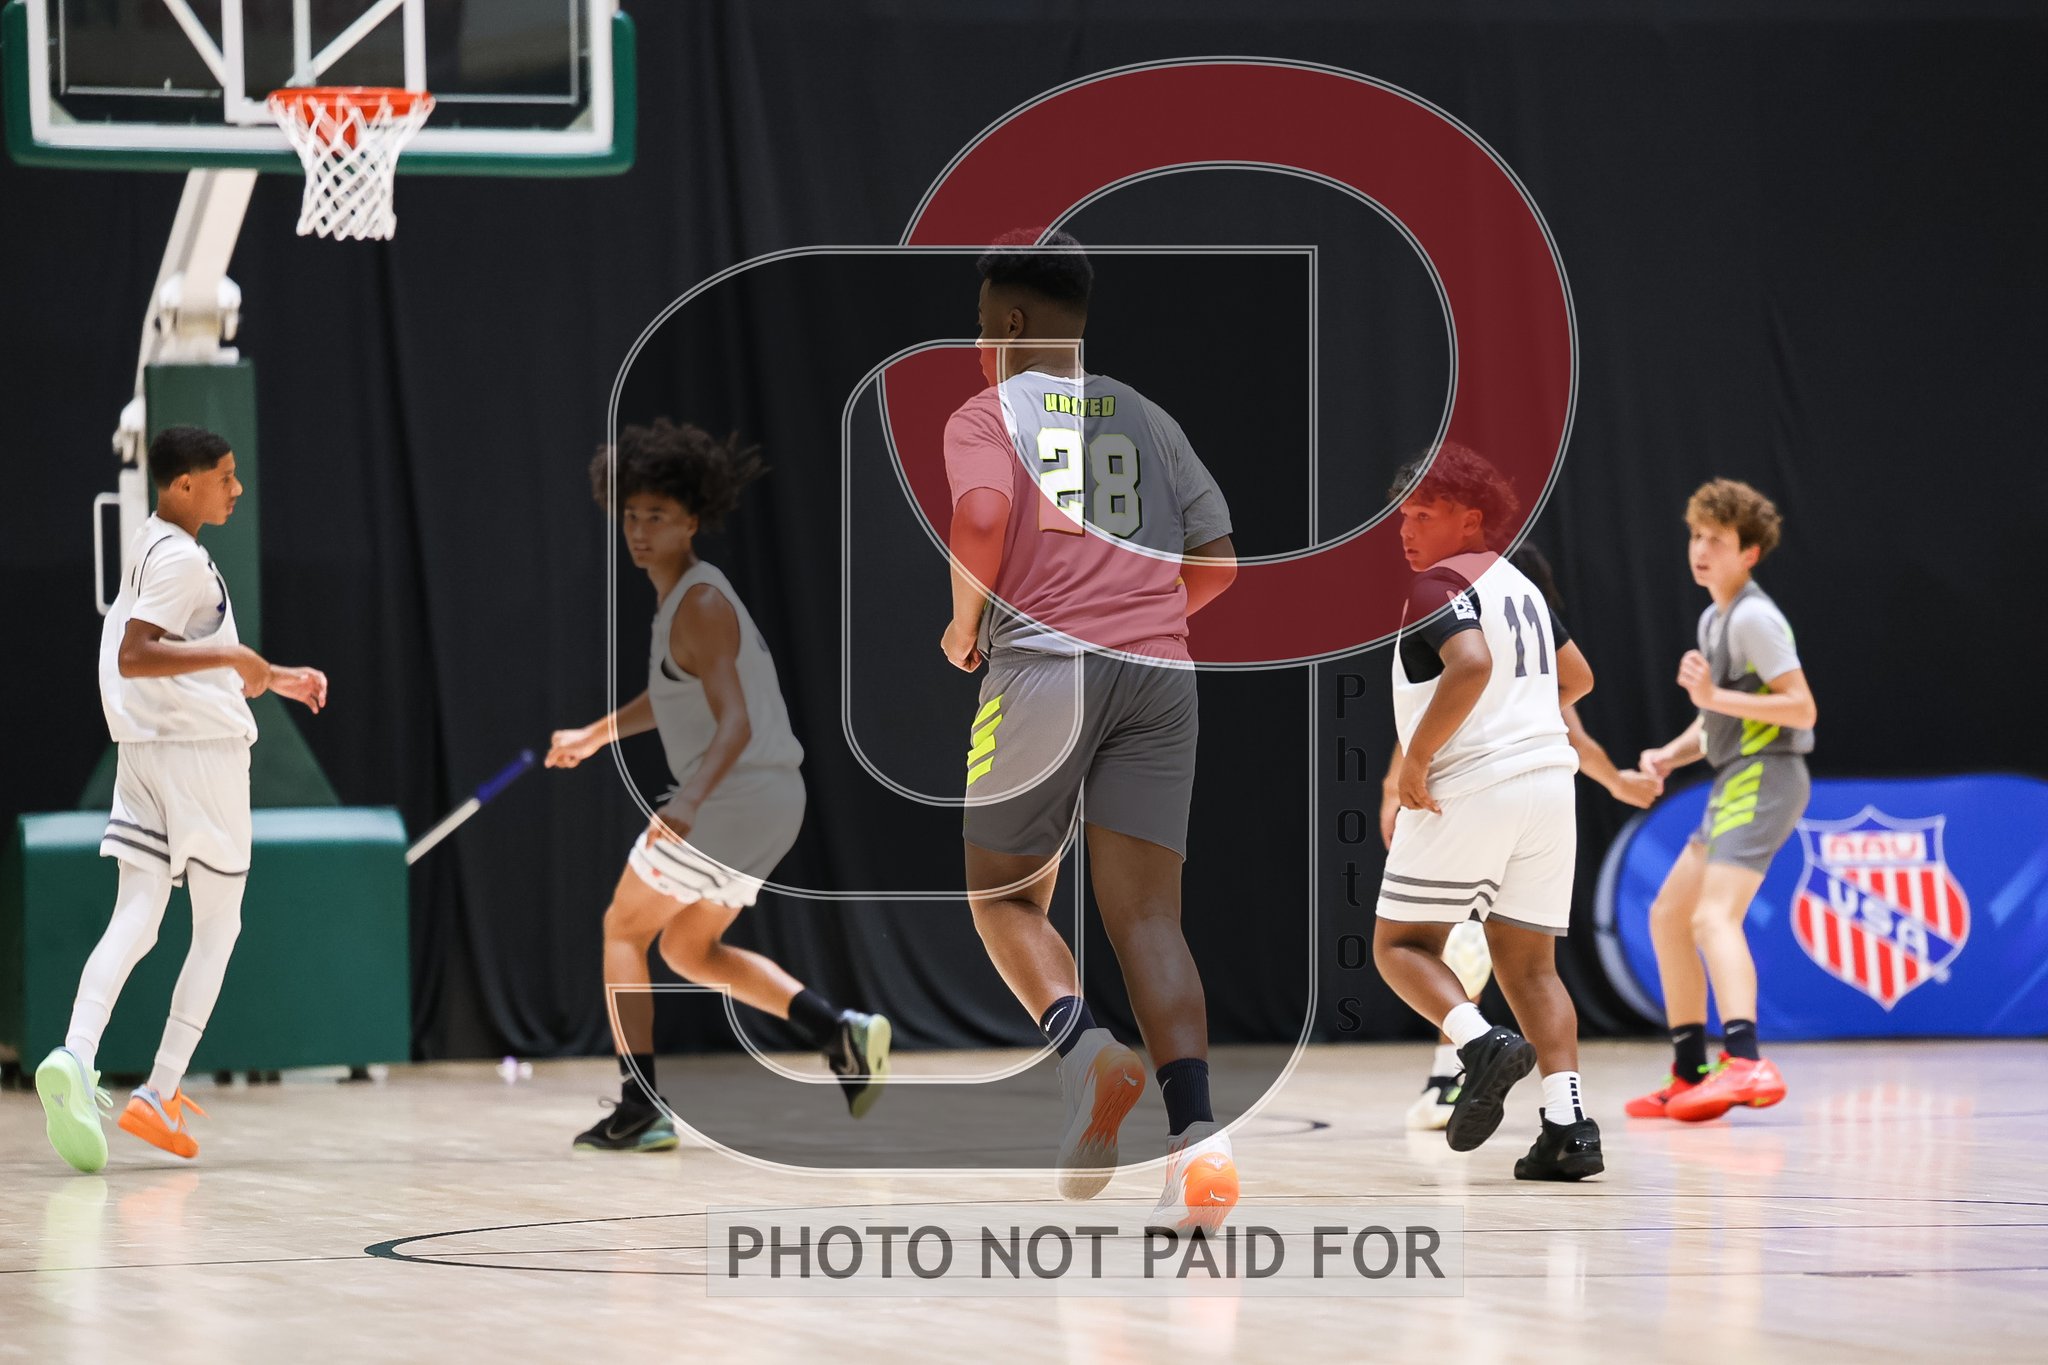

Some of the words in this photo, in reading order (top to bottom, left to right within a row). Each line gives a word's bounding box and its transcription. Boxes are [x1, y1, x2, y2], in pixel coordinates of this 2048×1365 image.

[1044, 393, 1115, 417] UNITED
[1036, 427, 1143, 538] 28
[1503, 594, 1549, 678] 11
[1828, 876, 1929, 963] USA
